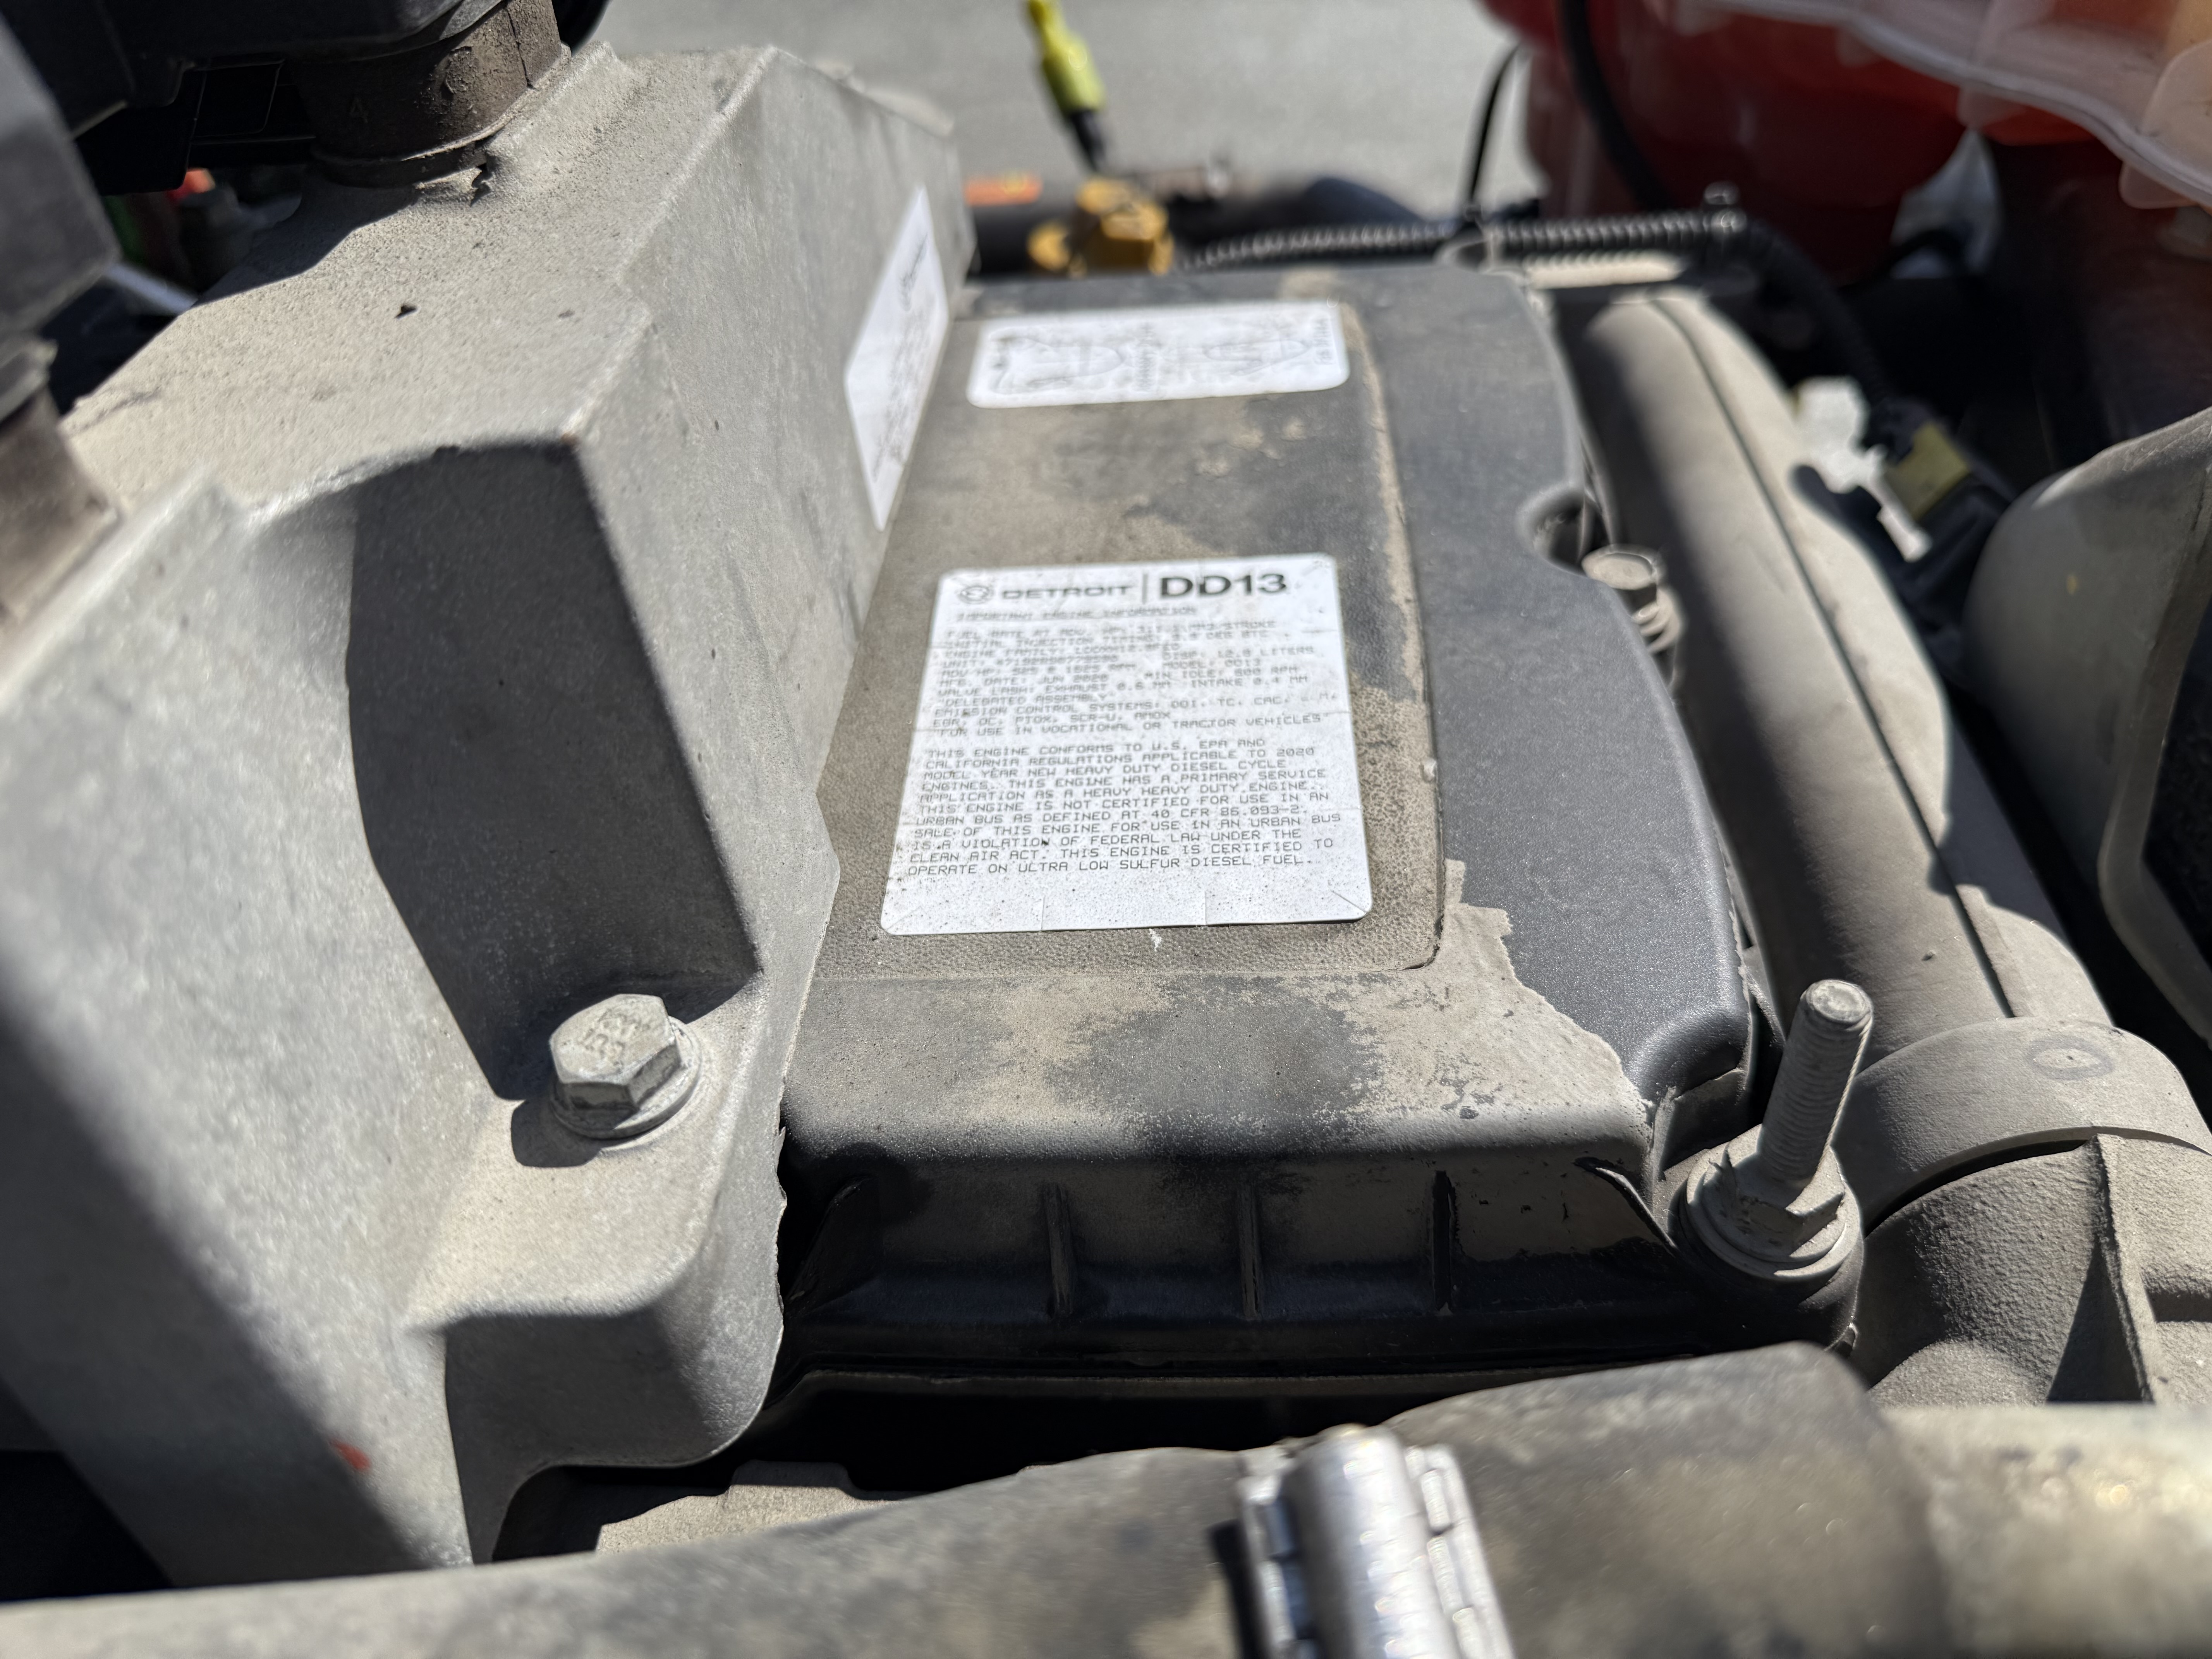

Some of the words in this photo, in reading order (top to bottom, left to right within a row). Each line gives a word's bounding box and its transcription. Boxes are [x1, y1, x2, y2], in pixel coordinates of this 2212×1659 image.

[1002, 585, 1133, 600] DETROIT
[1160, 573, 1287, 598] DD13
[976, 727, 1004, 736] USE
[1013, 726, 1031, 734] IN
[1041, 722, 1133, 733] VOCATIONAL
[1143, 721, 1160, 730] OR
[1171, 718, 1235, 728] TRACTOR
[924, 757, 1018, 769] CALIFORNIA
[1028, 753, 1132, 766] REGULATIONS
[1142, 750, 1237, 761] APPLICABLE
[1247, 749, 1266, 757] TO
[1276, 747, 1314, 757] 2020
[927, 749, 964, 758] THIS
[973, 747, 1029, 757] ENGINE
[1039, 744, 1113, 754] CONFORMS
[1123, 743, 1141, 751] TO
[1152, 741, 1187, 750] U.S.
[1199, 740, 1226, 749] EPA
[1237, 738, 1264, 747] AND
[923, 770, 970, 780] MODEL
[980, 768, 1018, 778] YEAR
[1027, 767, 1055, 776] NEW
[1065, 765, 1112, 775] HEAVY
[1122, 764, 1160, 773] DUTY
[1170, 761, 1227, 772] DIESEL
[1237, 759, 1285, 769] CYCLE
[1007, 779, 1045, 788] THIS
[1055, 776, 1112, 787] ENGINE
[1122, 775, 1151, 784] HAS
[1161, 774, 1170, 783] A
[1180, 771, 1247, 782] PRIMARY
[1258, 769, 1326, 780] SERVICE
[916, 804, 955, 814] THIS
[965, 802, 1023, 812] ENGINE
[1033, 801, 1052, 810] IS
[1062, 800, 1091, 809] NOT
[1101, 796, 1189, 808] CERTIFIED
[1200, 795, 1228, 804] FOR
[1239, 793, 1268, 803] USE
[1279, 792, 1298, 802] IN
[1309, 792, 1328, 800] AN
[920, 790, 1025, 802] APPLICATION
[1035, 790, 1054, 799] AS
[1064, 789, 1073, 797] A
[1083, 787, 1131, 797] HEAVY
[1141, 785, 1189, 795] HEAVY
[1200, 783, 1238, 793] DUTY
[913, 828, 952, 838] SALE
[962, 827, 982, 836] OF
[991, 825, 1031, 835] THIS
[1041, 823, 1100, 834] ENGINE
[1110, 822, 1140, 831] FOR
[1150, 820, 1179, 830] USE
[1190, 819, 1209, 829] IN
[1220, 818, 1240, 828] AN
[1250, 816, 1300, 827] URBAN
[1310, 814, 1340, 823] BUS
[915, 816, 964, 826] URBAN
[974, 814, 1003, 824] BUS
[1013, 813, 1032, 823] AS
[1042, 811, 1110, 822] DEFINED
[1121, 810, 1140, 819] AT
[1151, 809, 1169, 818] 40
[1180, 807, 1209, 817] CFR
[911, 841, 931, 850] IS
[941, 840, 951, 849] A
[960, 836, 1049, 849] VIOLATION
[1060, 836, 1079, 845] OF
[1090, 833, 1159, 845] FEDERAL
[1170, 832, 1199, 842] LAW
[1211, 830, 1260, 841] UNDER
[1271, 829, 1301, 839] THE
[909, 852, 959, 863] CLEAN
[969, 851, 999, 861] AIR
[1059, 848, 1099, 858] THIS
[1109, 845, 1169, 856] ENGINE
[1180, 844, 1199, 854] IS
[1211, 841, 1302, 853] CERTIFIED
[1312, 838, 1332, 848] TO
[907, 864, 977, 876] OPERATE
[987, 863, 1007, 873] ON
[1017, 861, 1067, 872] ULTRA
[1078, 860, 1108, 870] LOW
[1119, 858, 1179, 869] SULFUR
[1190, 855, 1251, 867] DIESEL
[1262, 854, 1310, 864] FUEL.
